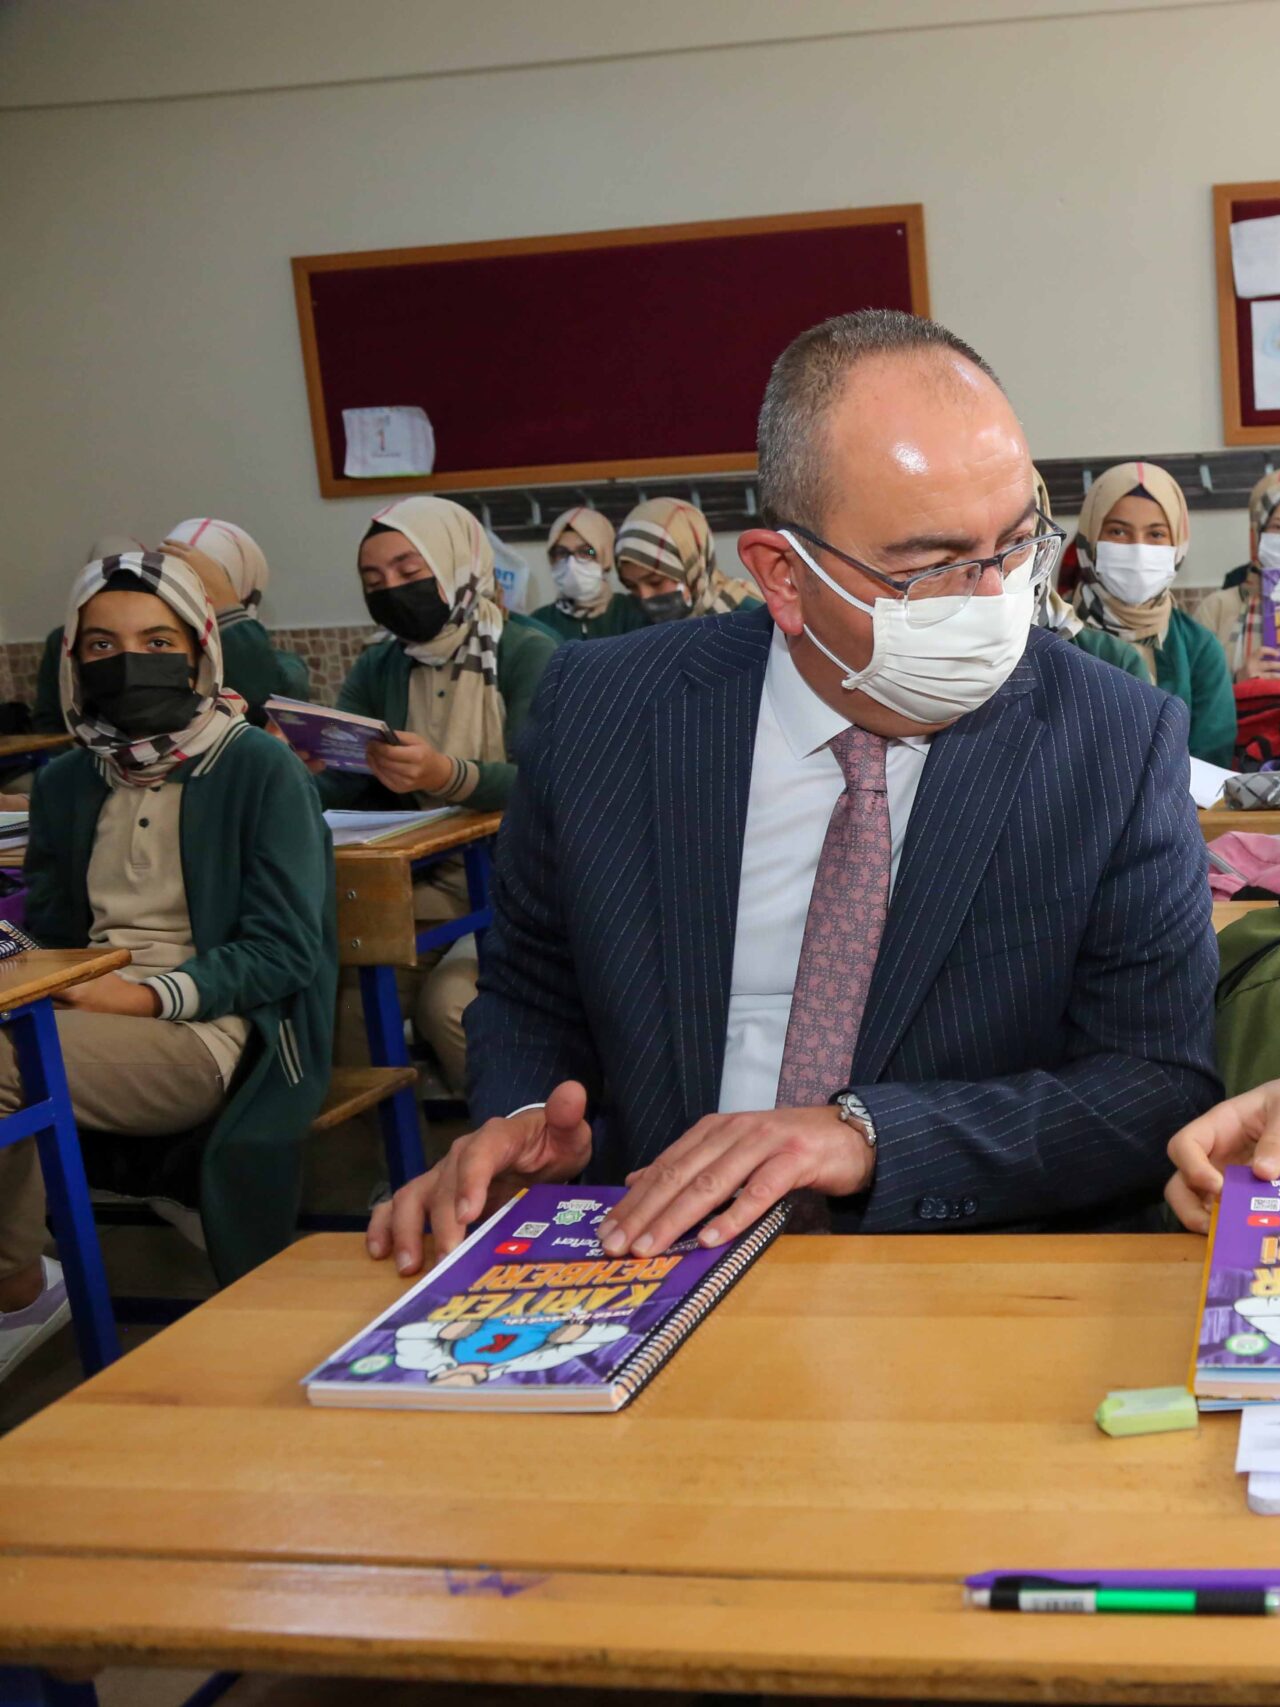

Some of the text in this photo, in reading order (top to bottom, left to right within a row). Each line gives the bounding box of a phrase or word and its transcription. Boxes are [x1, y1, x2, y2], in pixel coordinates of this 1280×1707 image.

[552, 1236, 600, 1248] Defteri
[468, 1256, 683, 1292] REHBERİ
[476, 1333, 518, 1353] K
